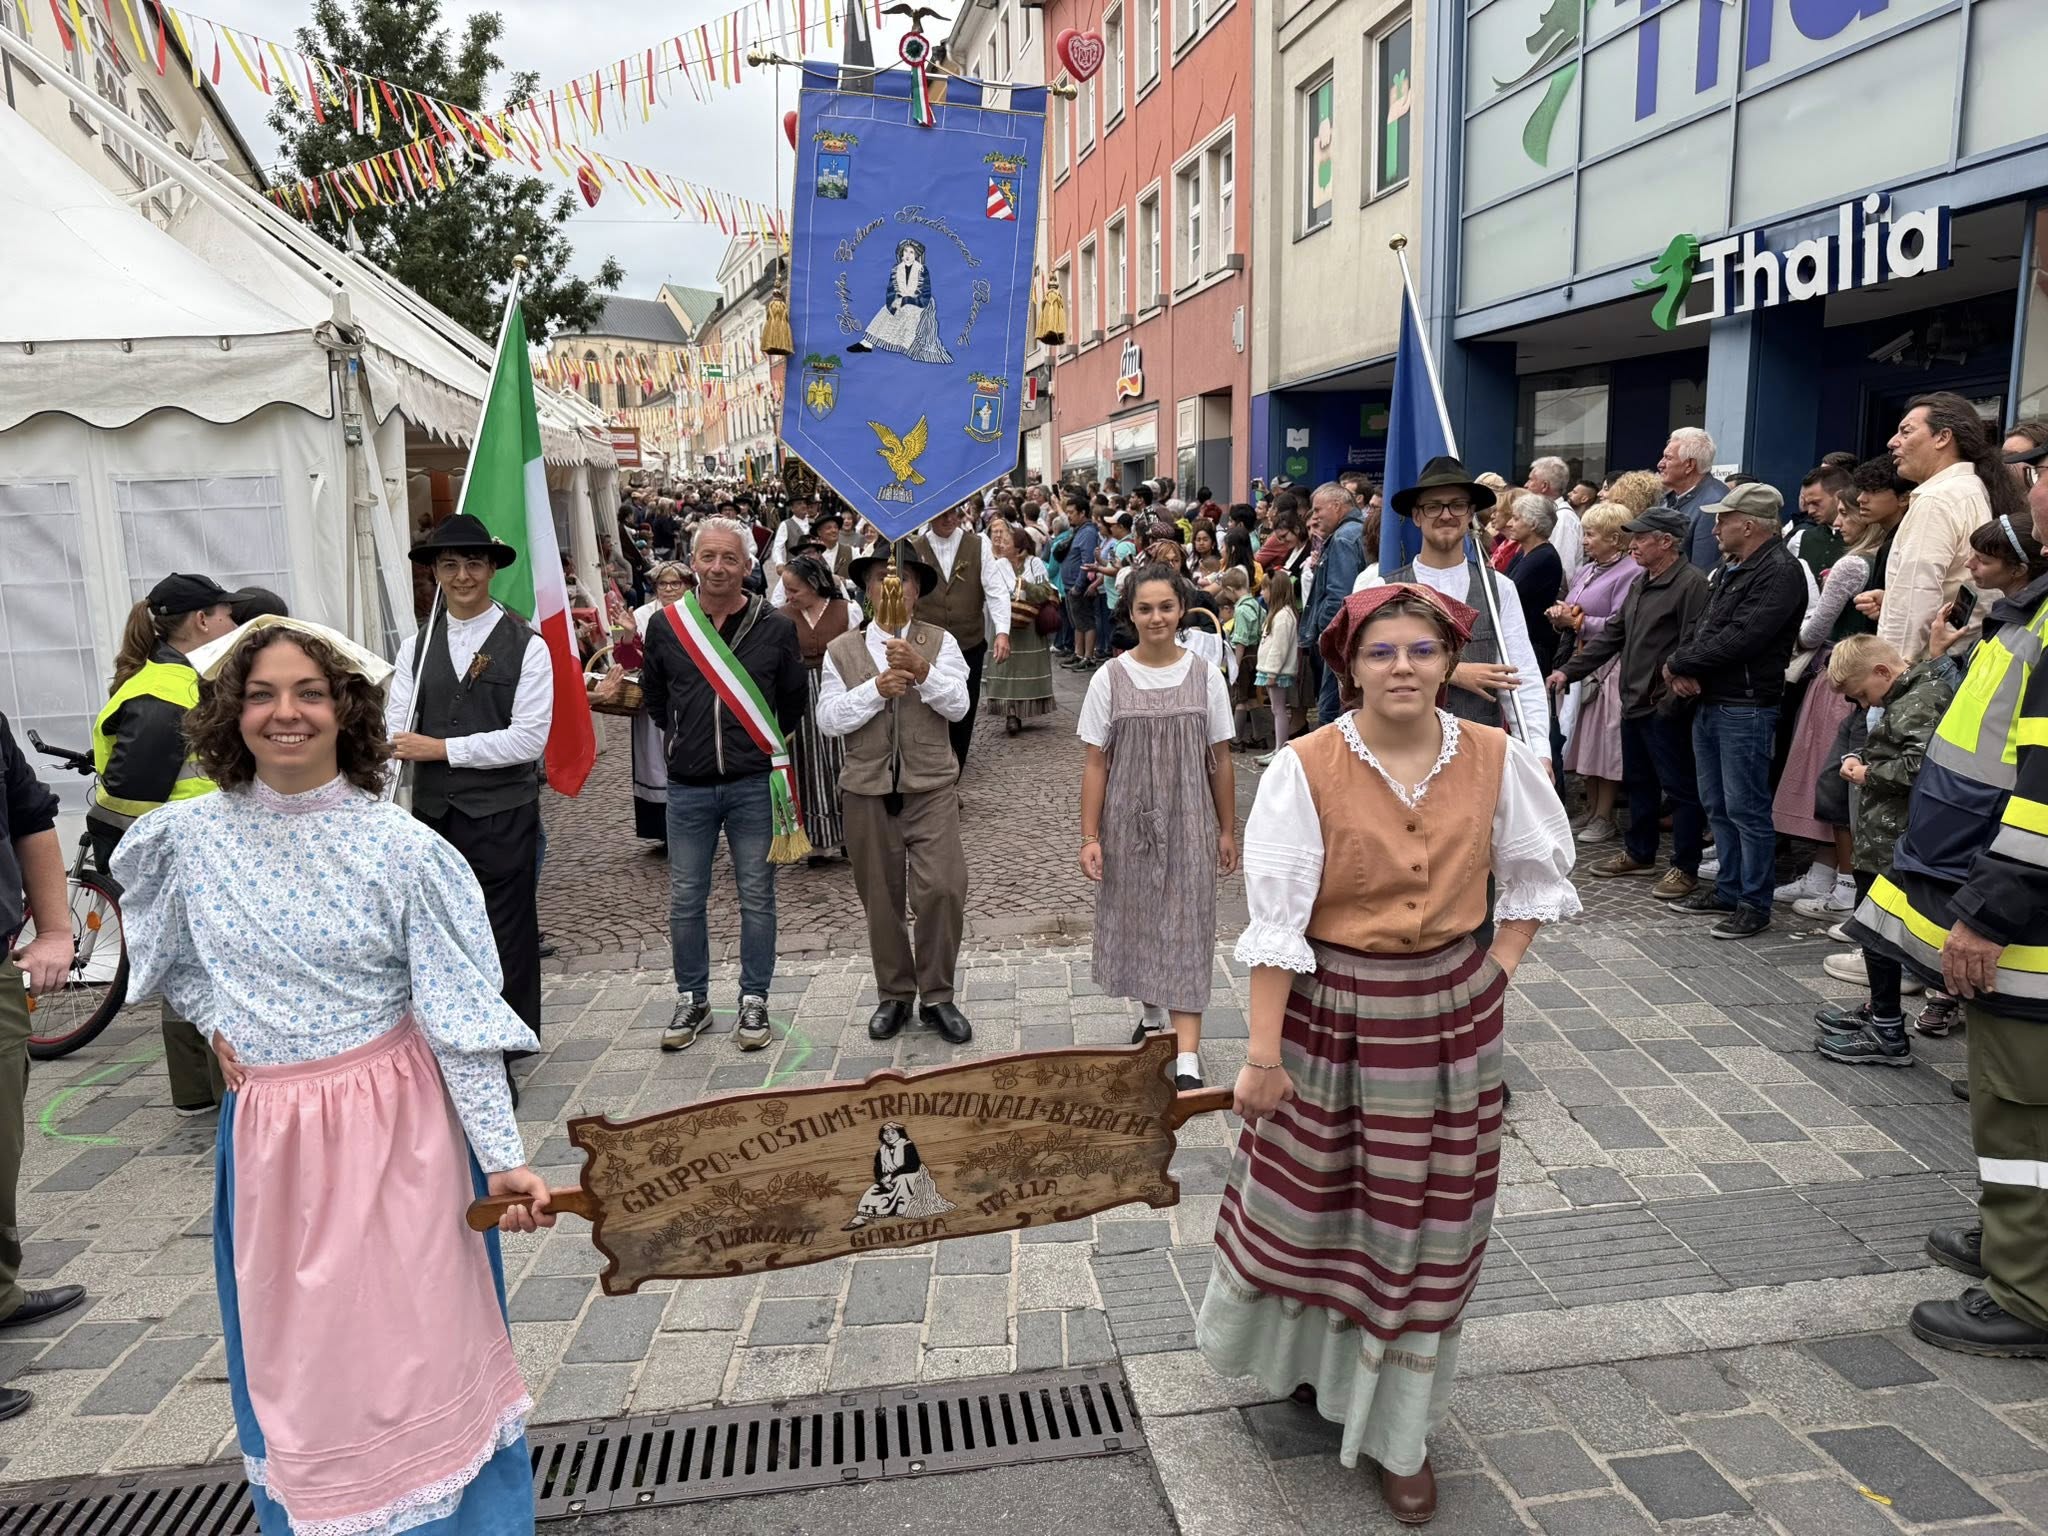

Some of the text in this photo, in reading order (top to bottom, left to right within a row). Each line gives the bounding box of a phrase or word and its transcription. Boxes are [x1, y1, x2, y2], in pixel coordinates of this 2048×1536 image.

[1699, 192, 1949, 318] Thalia
[1121, 340, 1139, 378] dm
[621, 1091, 1155, 1214] GRUPPO COSTUMI TRADIZIONALI BISIACHI
[695, 1179, 1062, 1253] TURRIACO GORIZIA ITALIA
